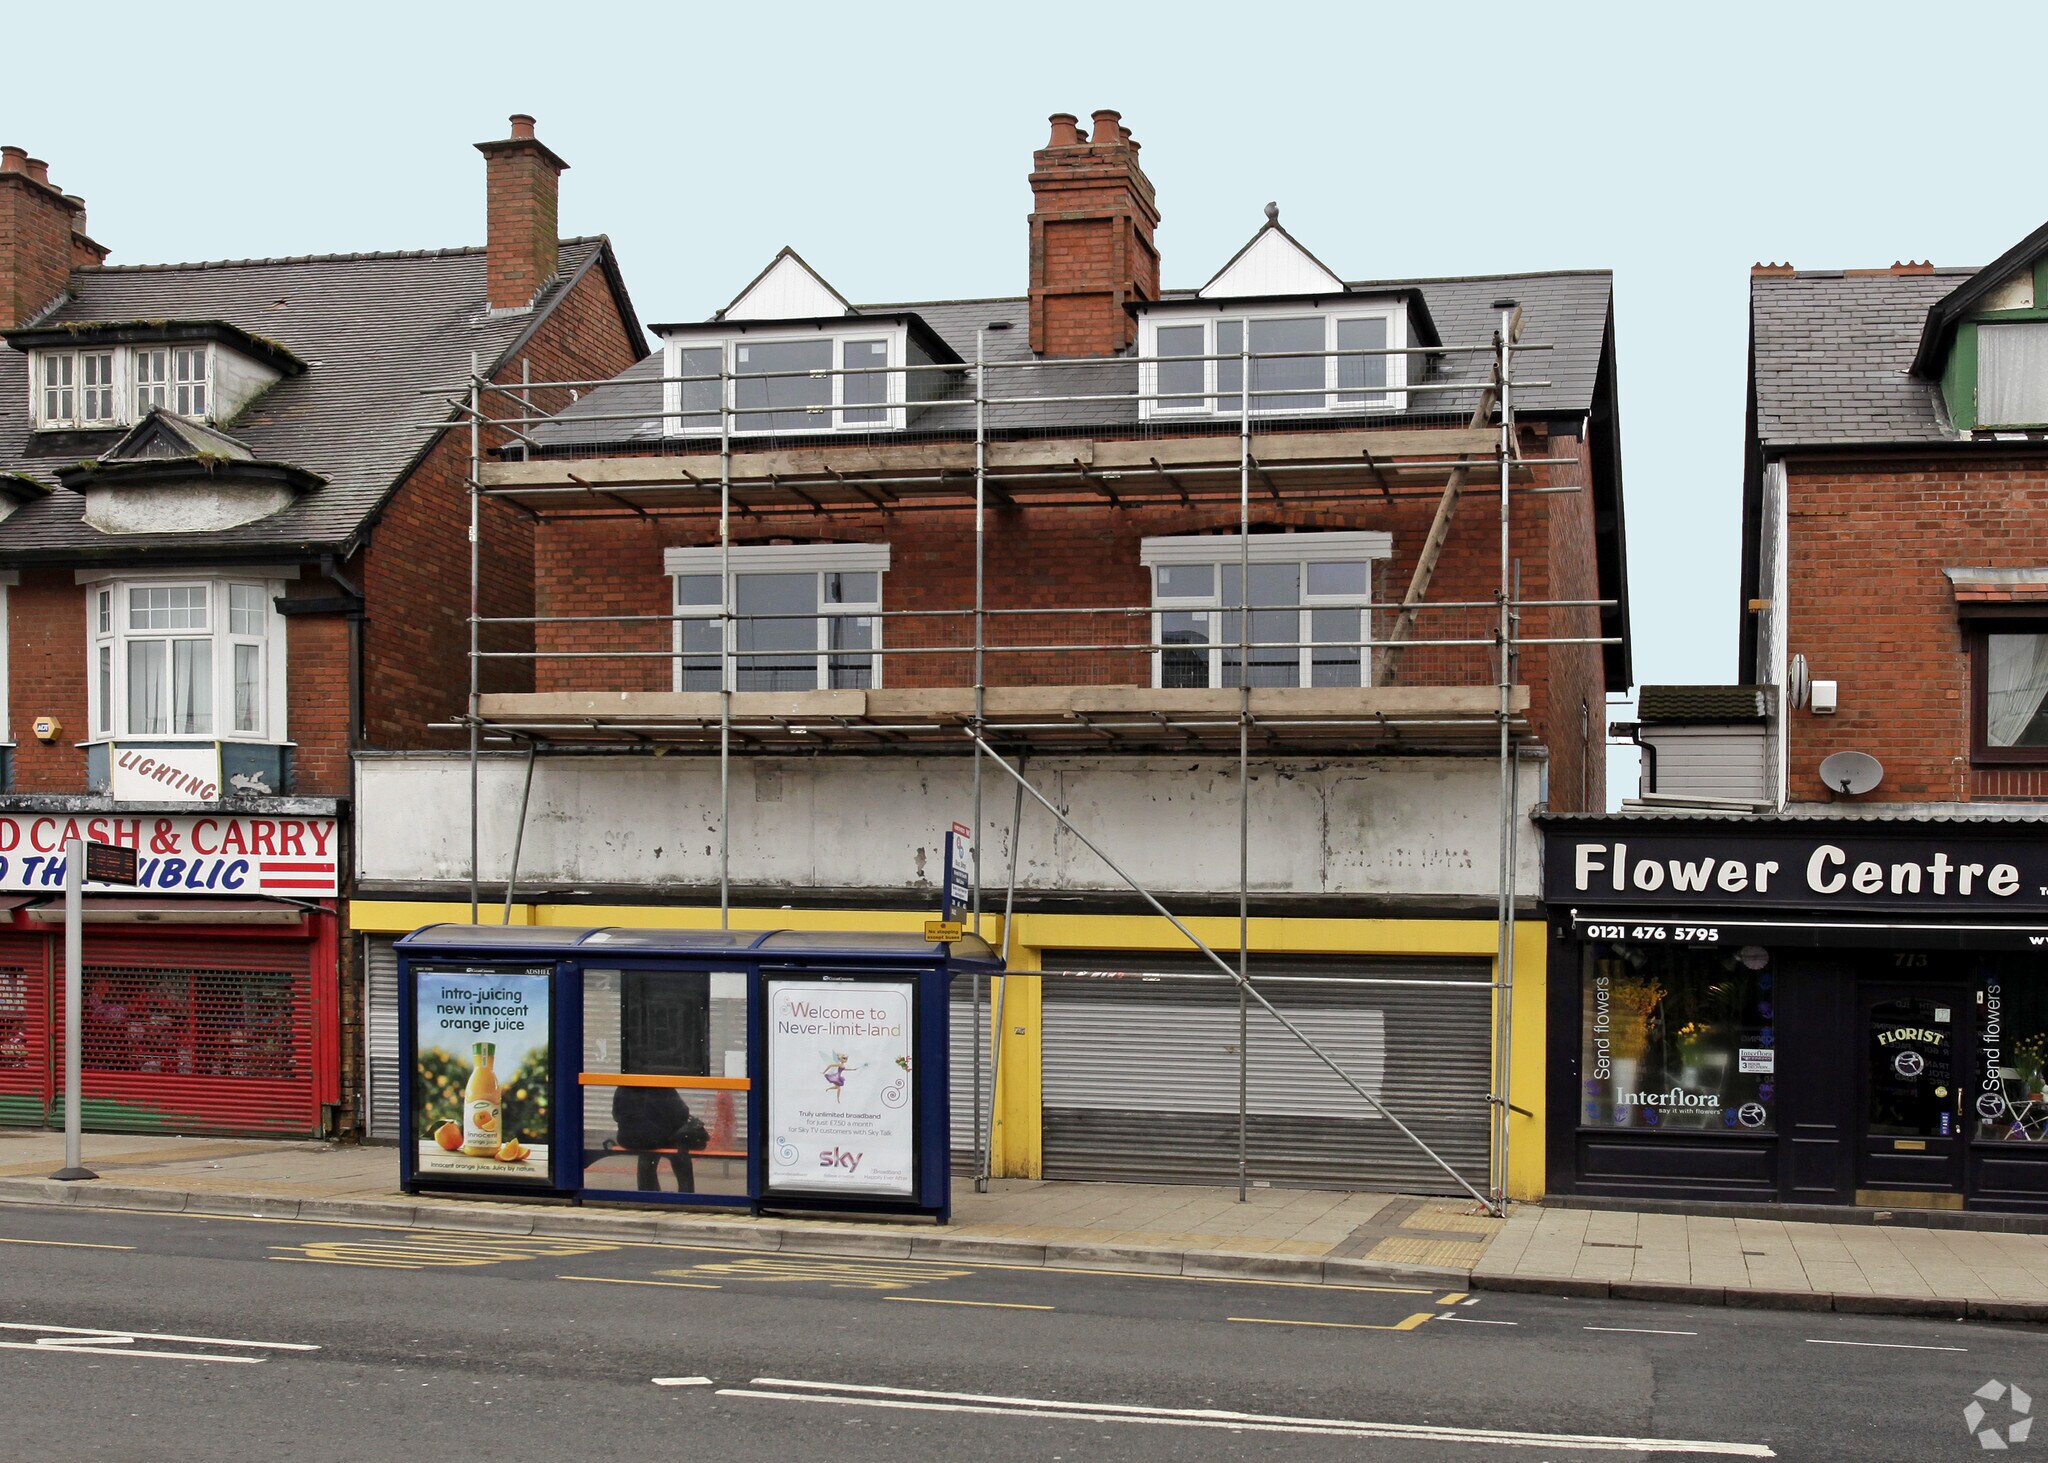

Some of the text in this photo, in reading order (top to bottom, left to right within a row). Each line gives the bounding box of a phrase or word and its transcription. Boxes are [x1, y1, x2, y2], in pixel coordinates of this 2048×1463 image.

[118, 750, 217, 800] LIGHTING
[30, 817, 140, 852] CASH
[150, 818, 181, 854] &
[191, 819, 335, 856] CARRY
[104, 857, 249, 889] UBLIC
[1575, 843, 2020, 896] Flower Centre
[1587, 925, 1719, 941] 0121 476 5795
[1893, 953, 1928, 967] 713
[441, 987, 522, 1003] intro-juicing
[437, 1003, 529, 1016] new innocent
[790, 1002, 886, 1020] Welcome to
[440, 1018, 525, 1033] orange juice
[778, 1021, 901, 1036] Never-limit-land
[1593, 976, 1610, 1080] Send flowers
[1877, 1027, 1944, 1045] FLORIST
[1982, 984, 2000, 1091] Send flowers
[1616, 1087, 1720, 1107] Interflora
[846, 1112, 881, 1120] broadband
[820, 1146, 863, 1173] sky
